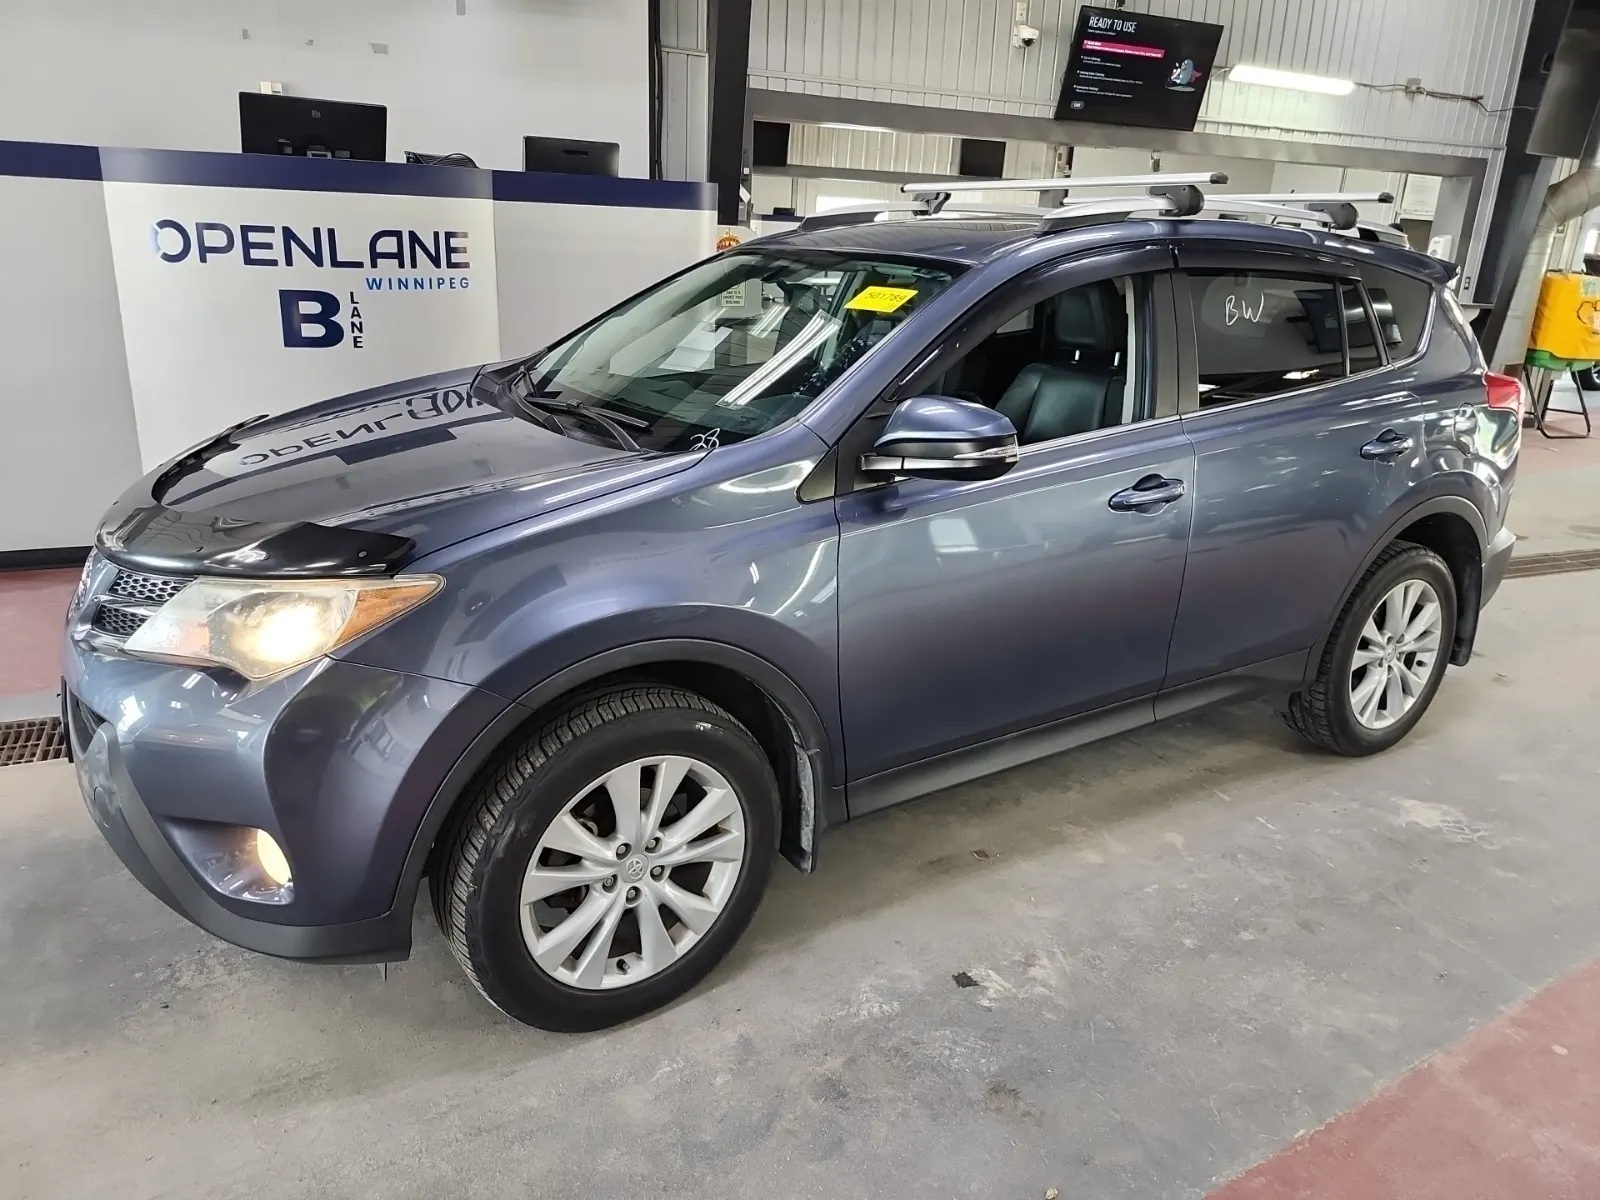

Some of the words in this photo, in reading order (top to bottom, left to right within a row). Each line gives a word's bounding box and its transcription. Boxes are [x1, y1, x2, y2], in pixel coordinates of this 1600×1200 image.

[1088, 16, 1113, 29] READY
[1113, 19, 1123, 31] TO
[1122, 21, 1137, 33] USE
[151, 219, 471, 269] OPENLANE
[365, 277, 470, 291] WINNIPEG
[864, 291, 907, 302] 501789
[278, 289, 345, 349] B
[349, 291, 364, 349] LANE
